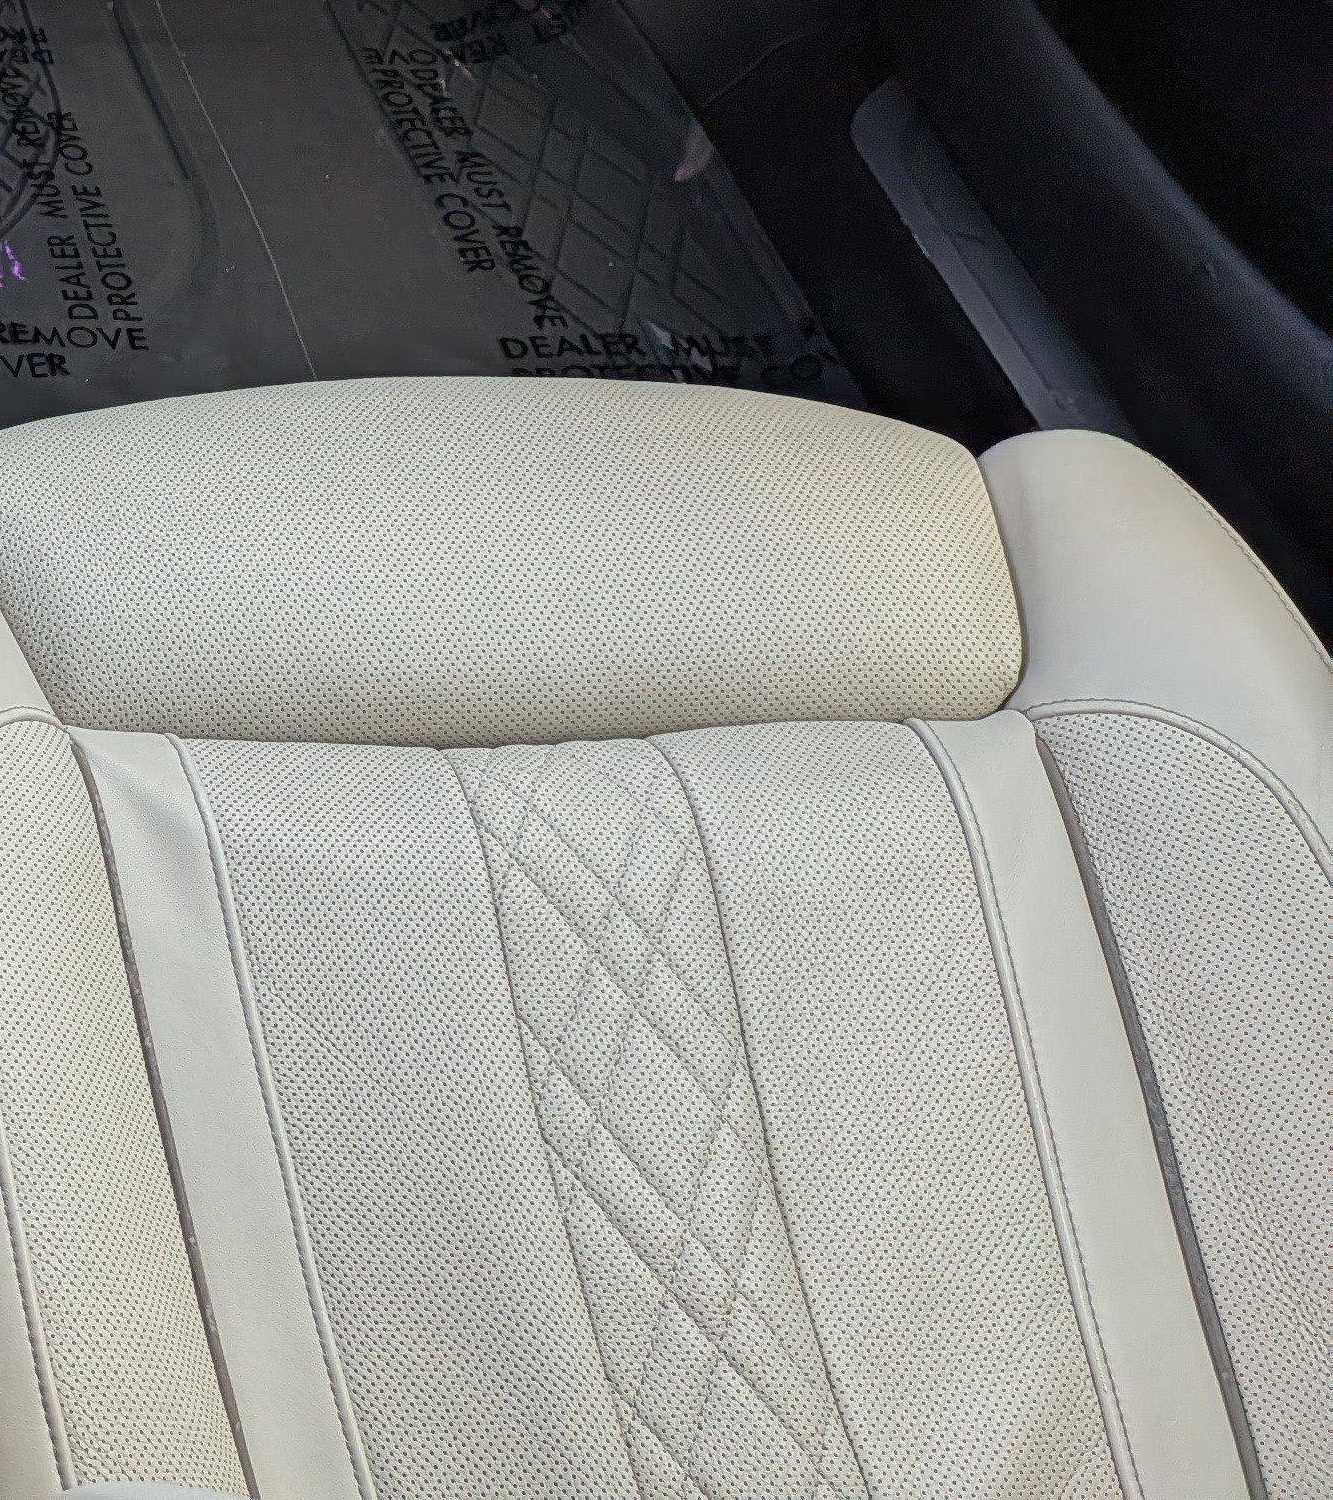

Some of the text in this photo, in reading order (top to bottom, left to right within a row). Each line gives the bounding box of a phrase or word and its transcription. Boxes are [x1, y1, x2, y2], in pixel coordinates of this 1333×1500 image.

[375, 67, 497, 274] PROTECTIVE COVER
[453, 149, 513, 214] MUST
[47, 111, 137, 323] COVER PROTECTIVE
[47, 235, 99, 323] DEALER
[497, 332, 646, 359] DEALER
